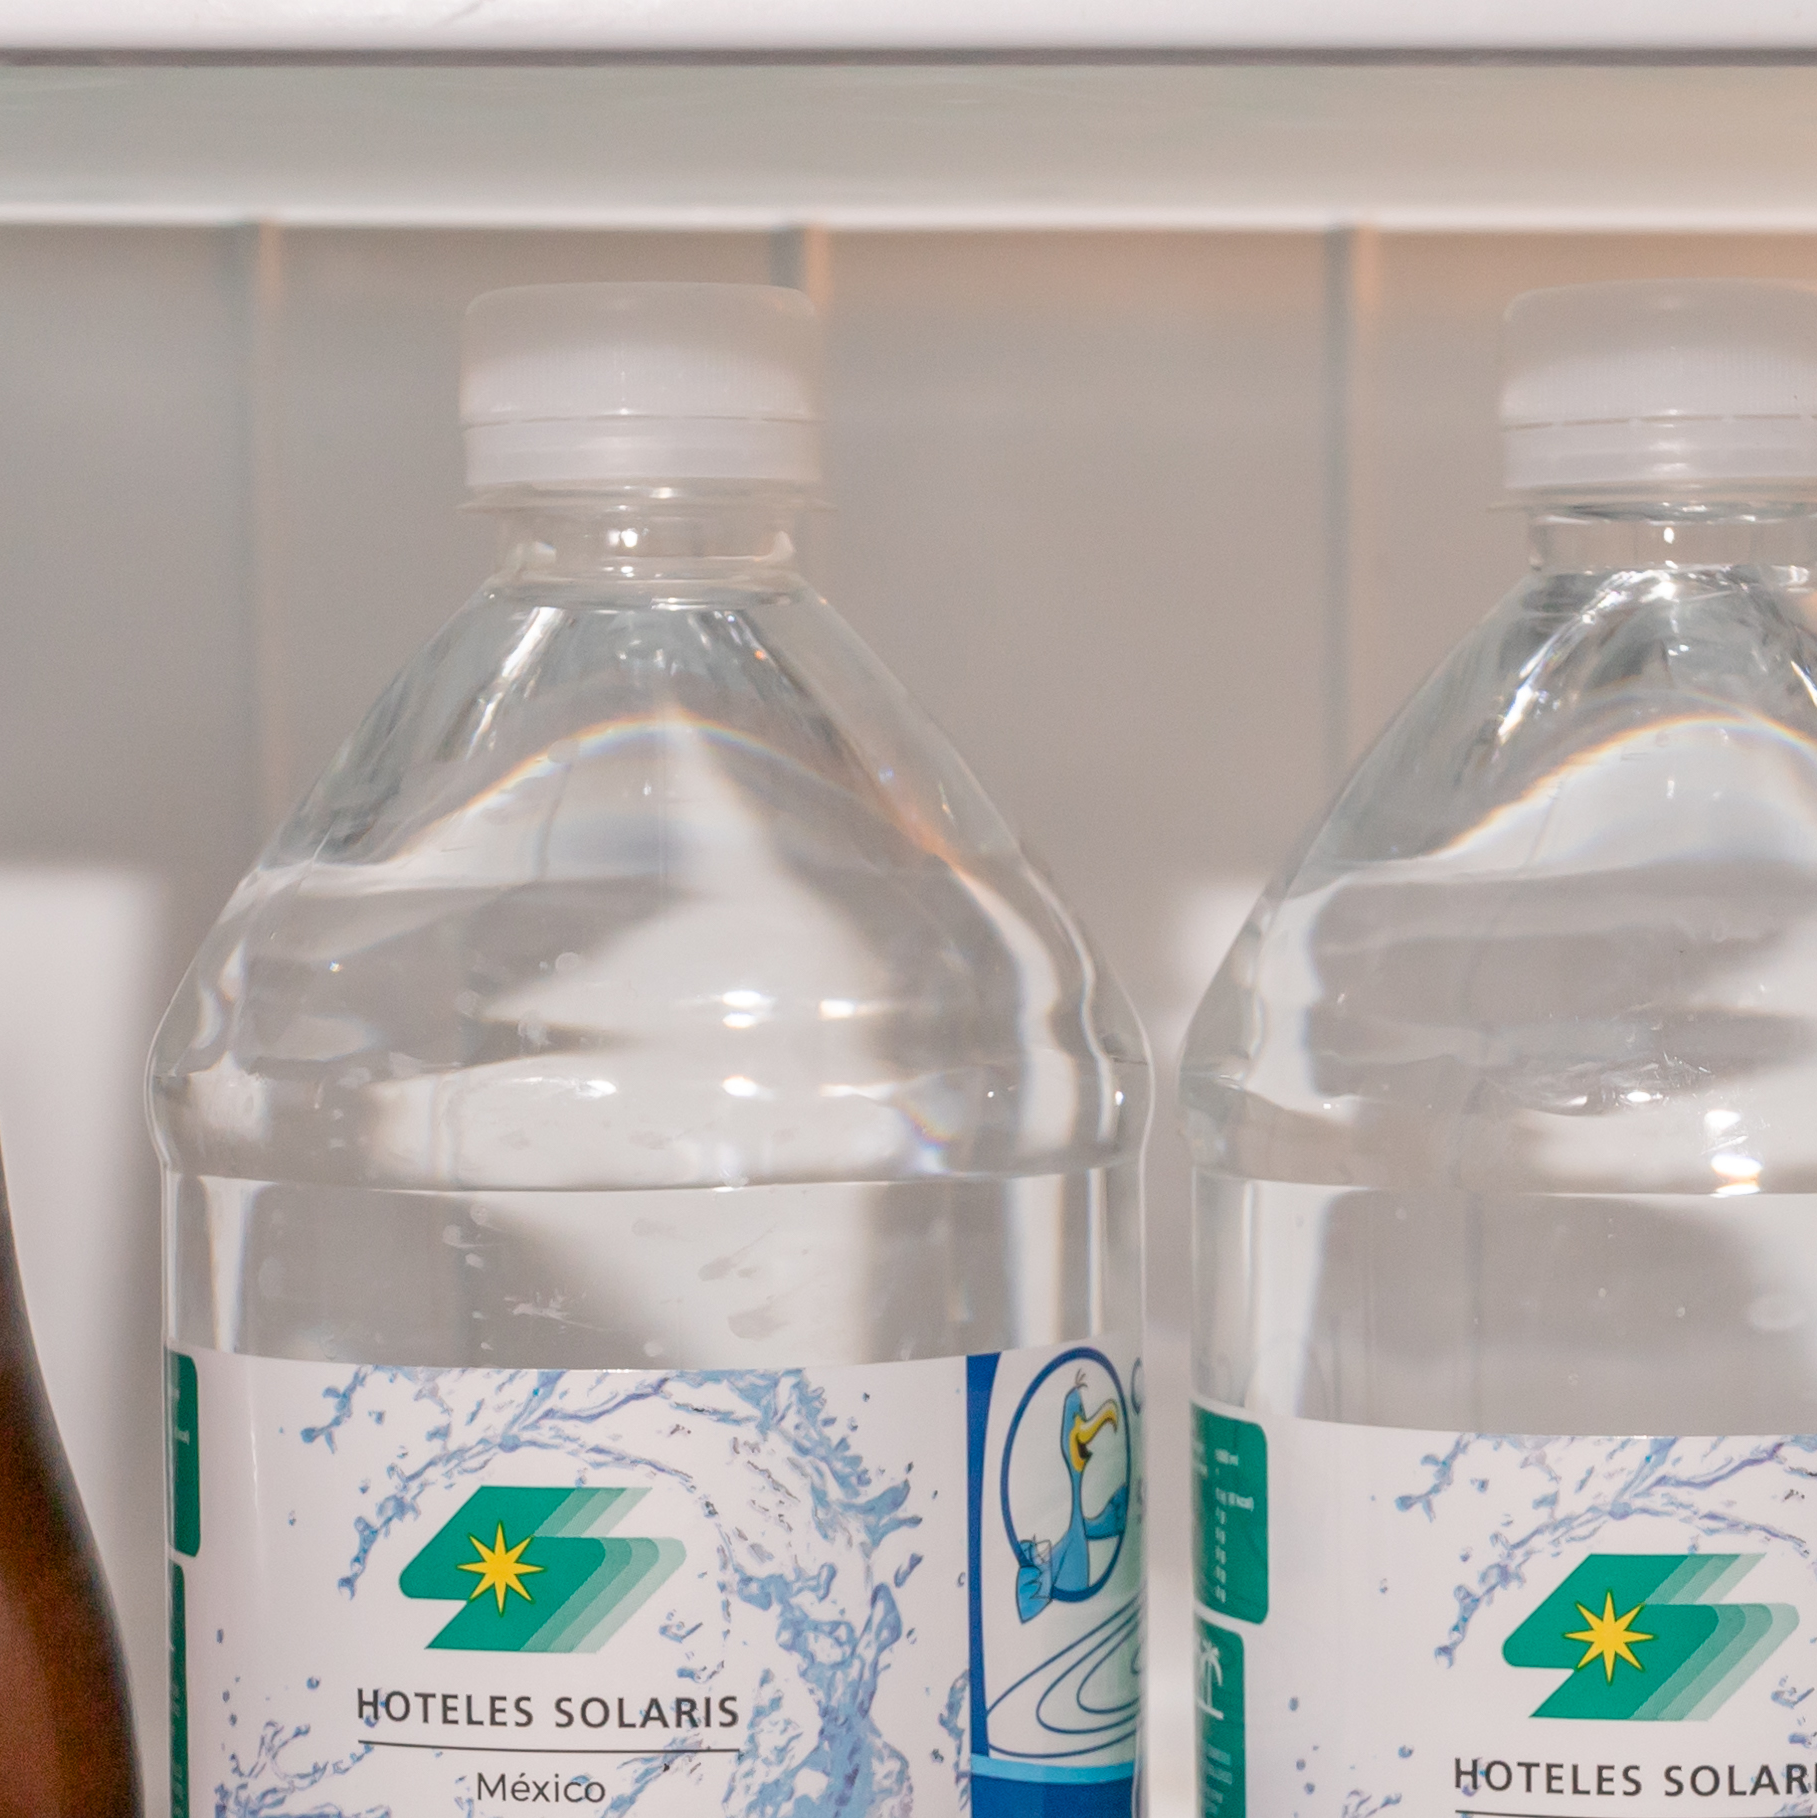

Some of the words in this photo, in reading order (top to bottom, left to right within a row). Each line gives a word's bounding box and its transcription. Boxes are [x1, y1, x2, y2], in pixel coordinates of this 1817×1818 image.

[357, 1688, 534, 1728] HOTELES
[554, 1696, 740, 1729] SOLARIS
[477, 1772, 606, 1804] México
[1454, 1757, 1642, 1797] HOTELES
